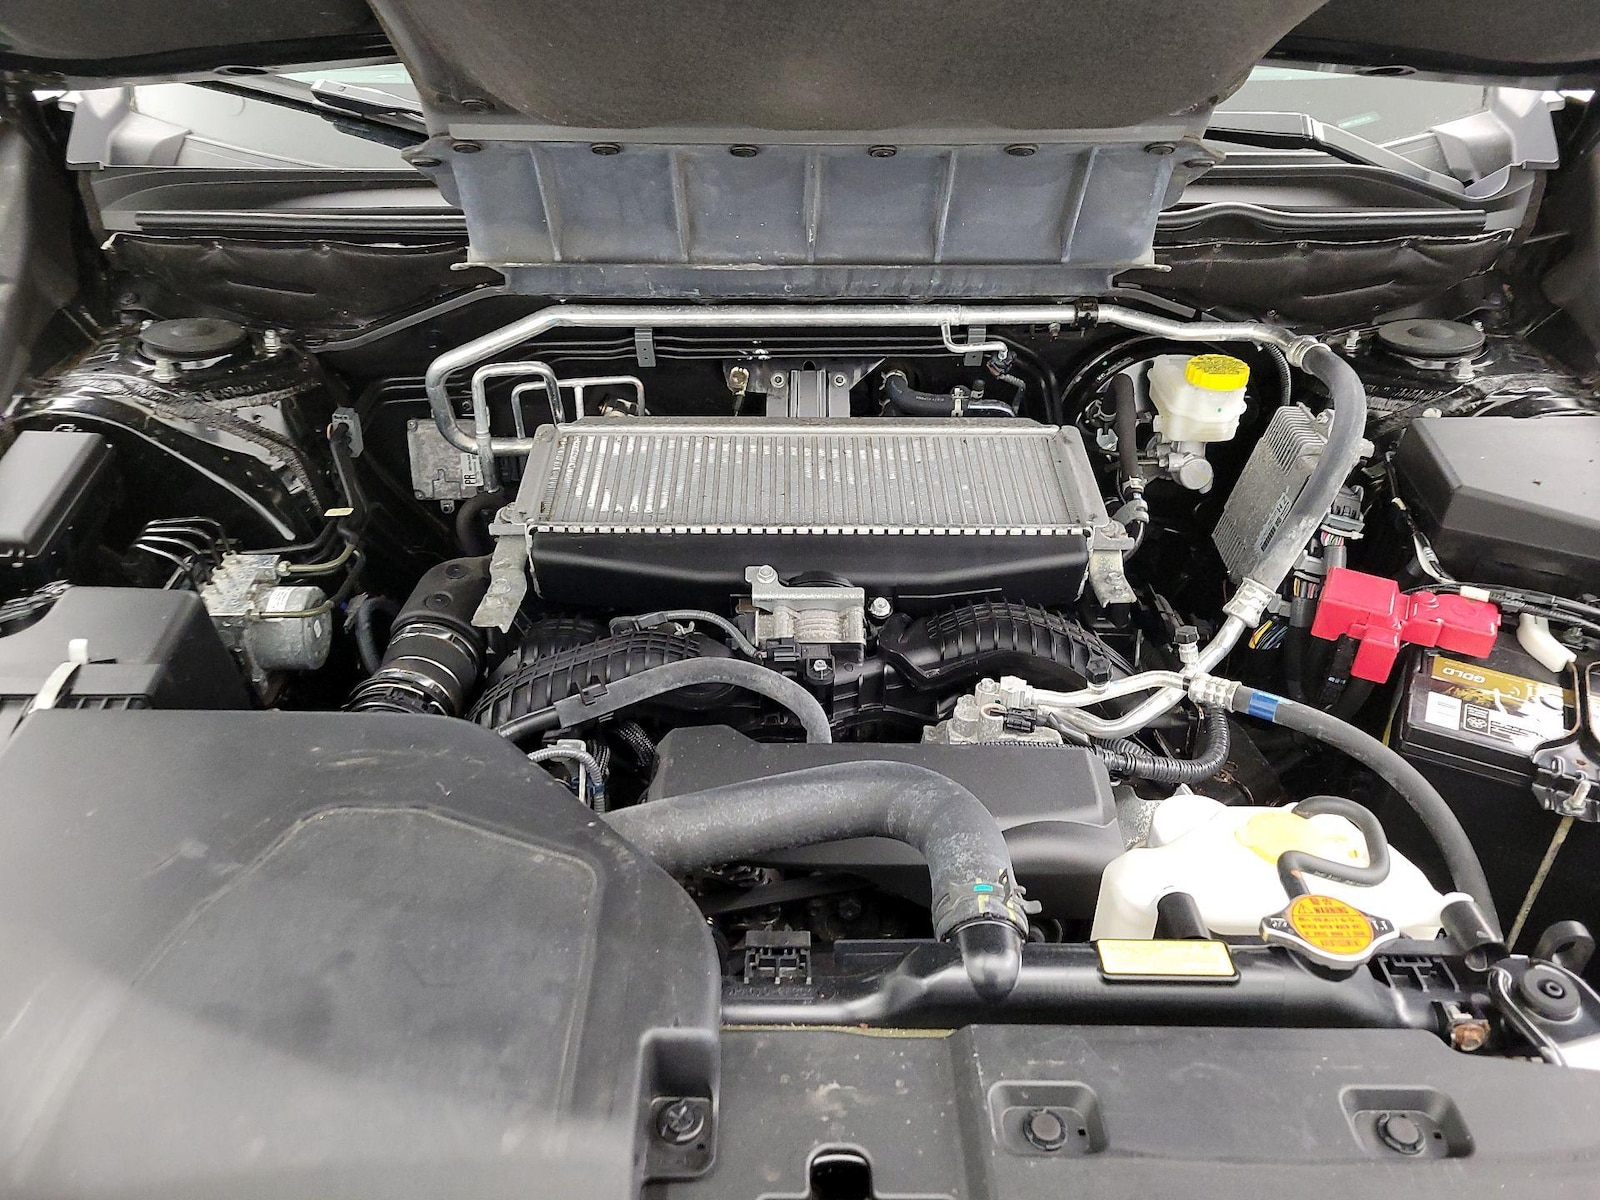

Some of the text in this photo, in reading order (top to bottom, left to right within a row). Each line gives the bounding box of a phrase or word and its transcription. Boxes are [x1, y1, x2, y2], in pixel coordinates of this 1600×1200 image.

[464, 475, 476, 484] PR
[1442, 667, 1486, 684] GOLD
[1314, 906, 1350, 914] WARNING
